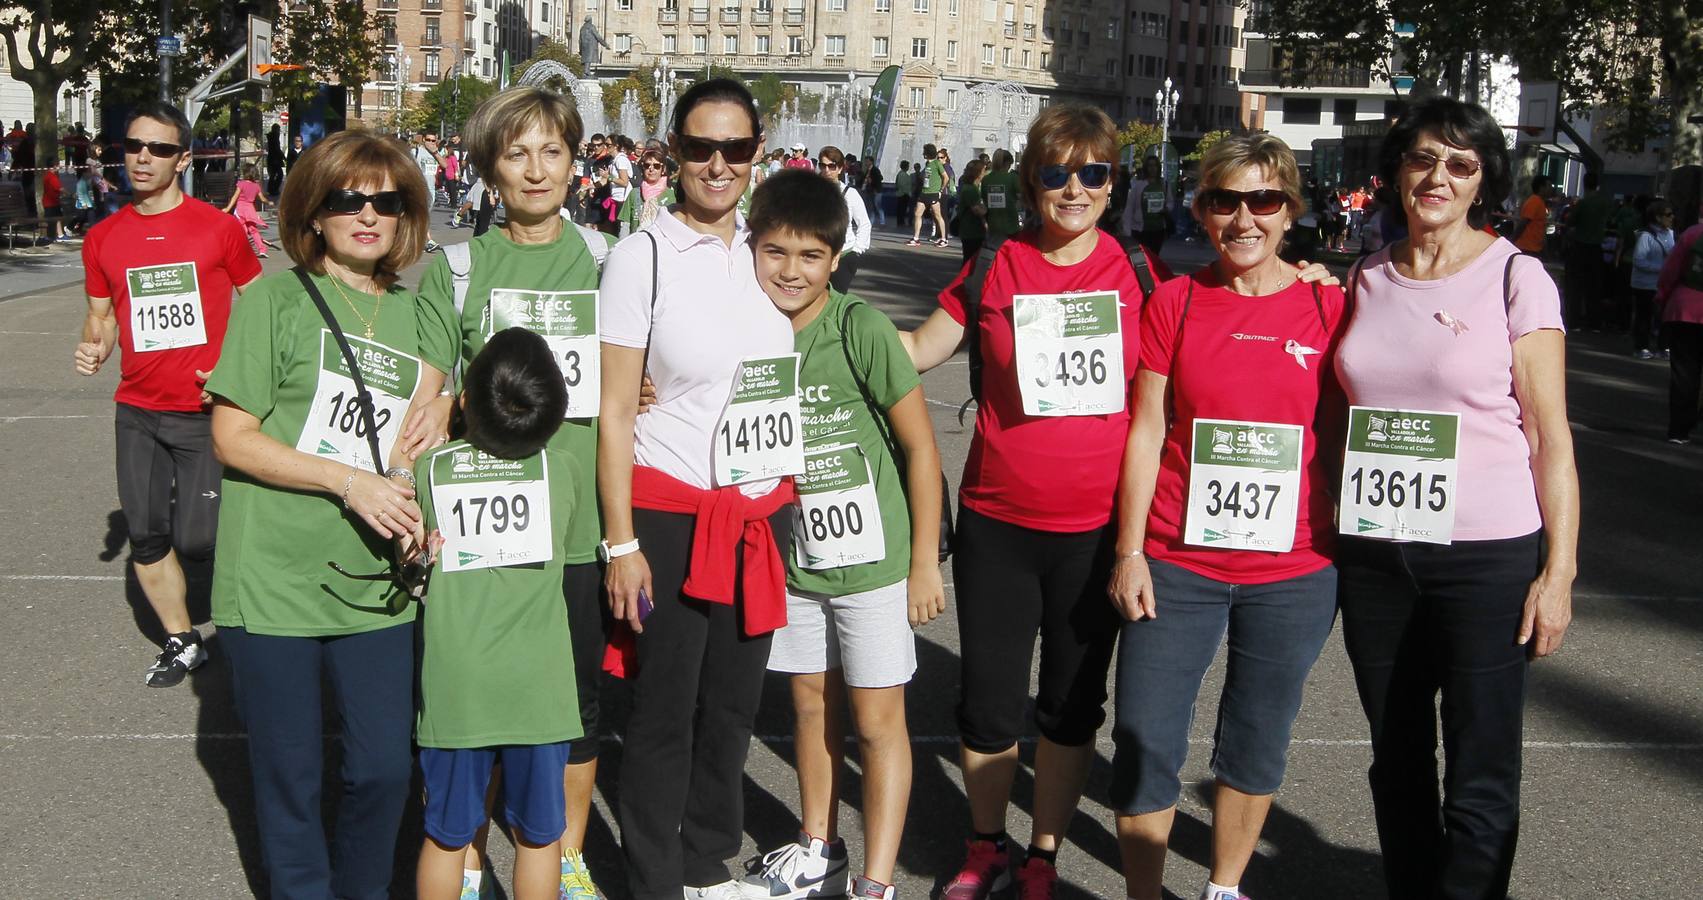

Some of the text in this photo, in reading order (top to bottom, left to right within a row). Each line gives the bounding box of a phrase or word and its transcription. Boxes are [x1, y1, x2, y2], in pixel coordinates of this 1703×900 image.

[155, 269, 178, 279] aecc
[535, 300, 572, 311] aecc
[1058, 301, 1092, 313] aecc
[137, 302, 195, 331] 11588
[363, 349, 398, 368] aecc
[745, 364, 776, 377] aecc
[1035, 349, 1106, 388] 3436
[800, 406, 853, 425] marcha
[1391, 418, 1431, 431] aecc
[721, 412, 793, 456] 14130
[1237, 430, 1275, 444] aecc
[1403, 434, 1436, 444] marcha
[807, 455, 842, 471] aecc
[1351, 467, 1447, 512] 13615
[1206, 480, 1280, 520] 3437
[452, 494, 530, 537] 1799
[800, 502, 863, 541] 1800
